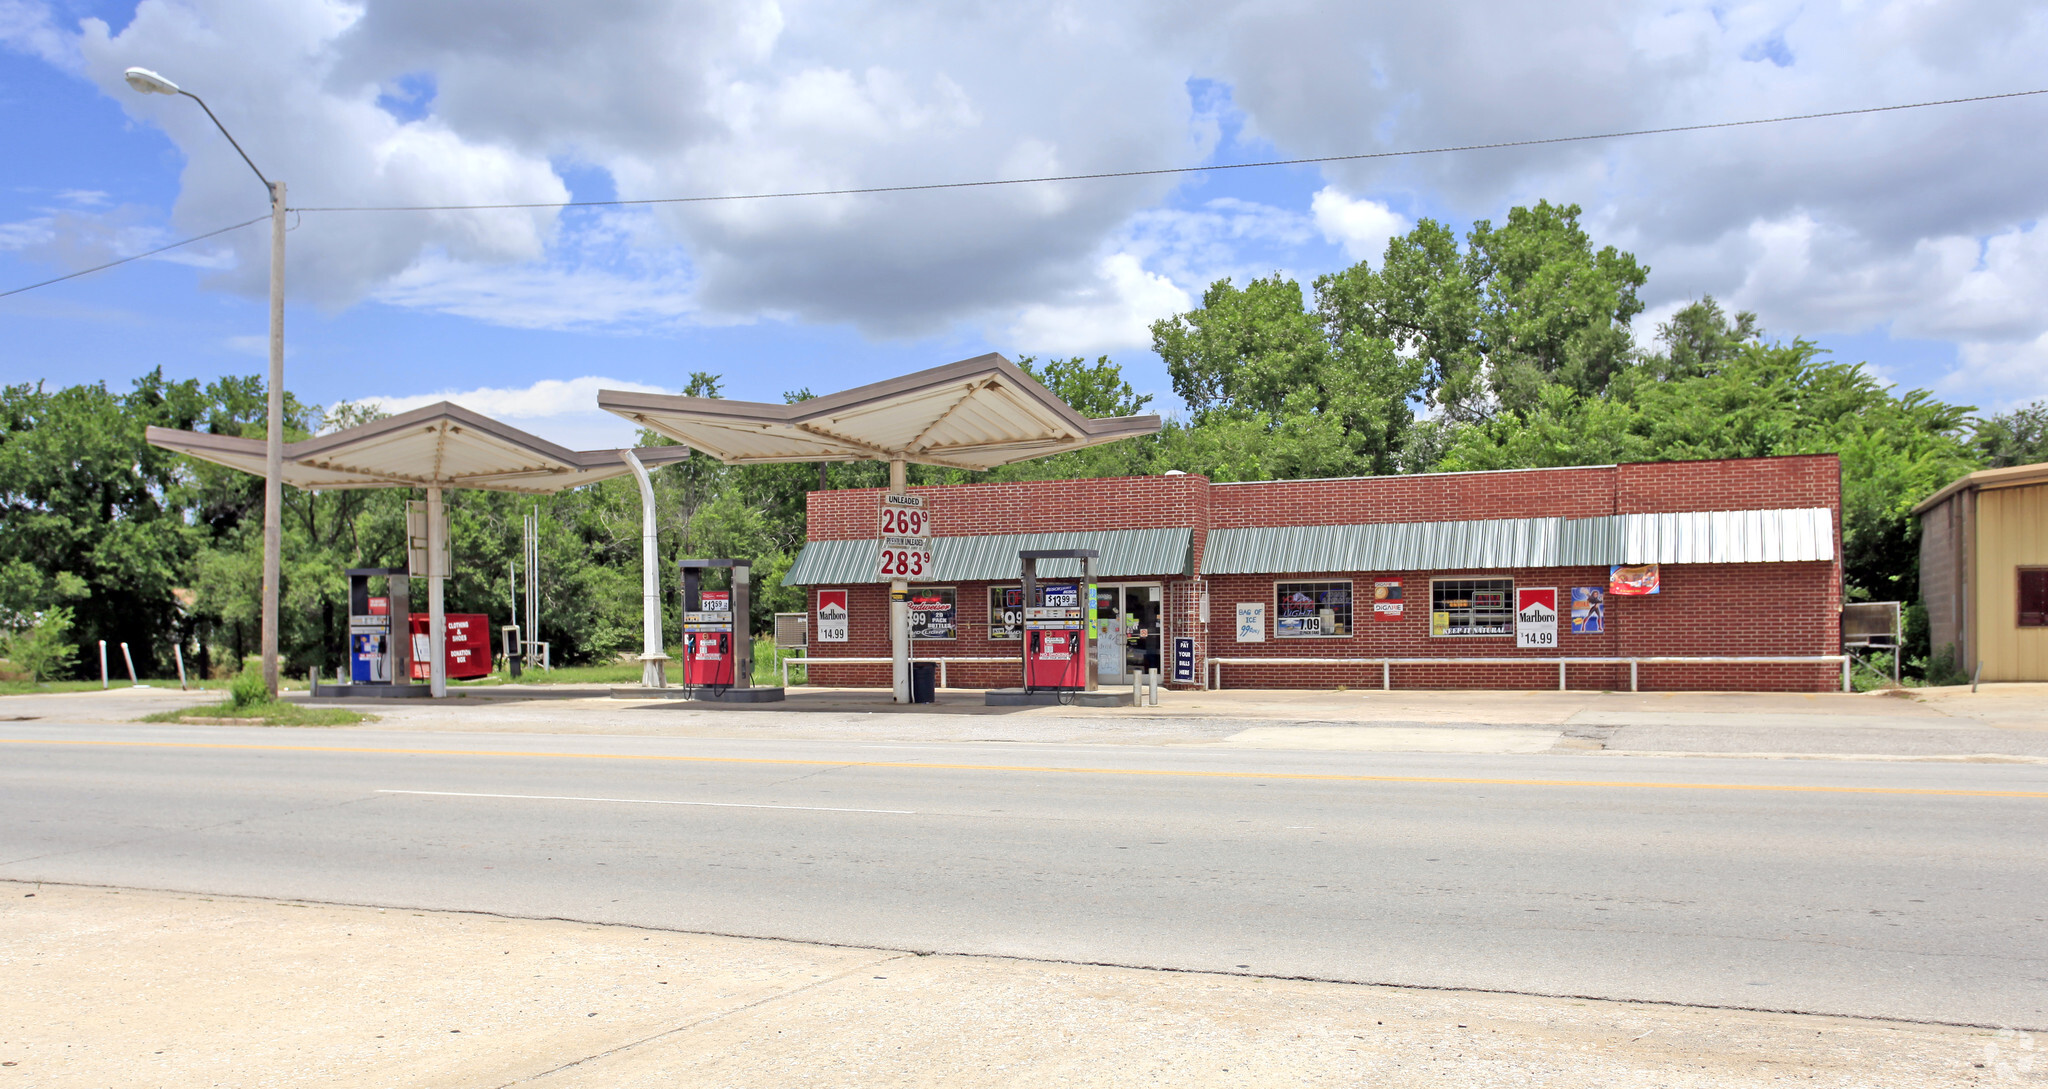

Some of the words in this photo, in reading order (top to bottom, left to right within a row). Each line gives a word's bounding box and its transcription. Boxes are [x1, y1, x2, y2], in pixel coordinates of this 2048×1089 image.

[888, 495, 920, 506] UNLEADED
[1475, 594, 1501, 606] ATM
[907, 601, 951, 611] Budweiser
[819, 608, 846, 620] Marlboro
[1283, 609, 1313, 617] LIGHT
[1519, 610, 1555, 623] Marlboro
[448, 621, 469, 629] CLOTHING
[1299, 618, 1320, 630] 7.09
[1443, 627, 1462, 635] KEEP
[452, 634, 467, 642] SHOES
[450, 649, 471, 657] DONATION
